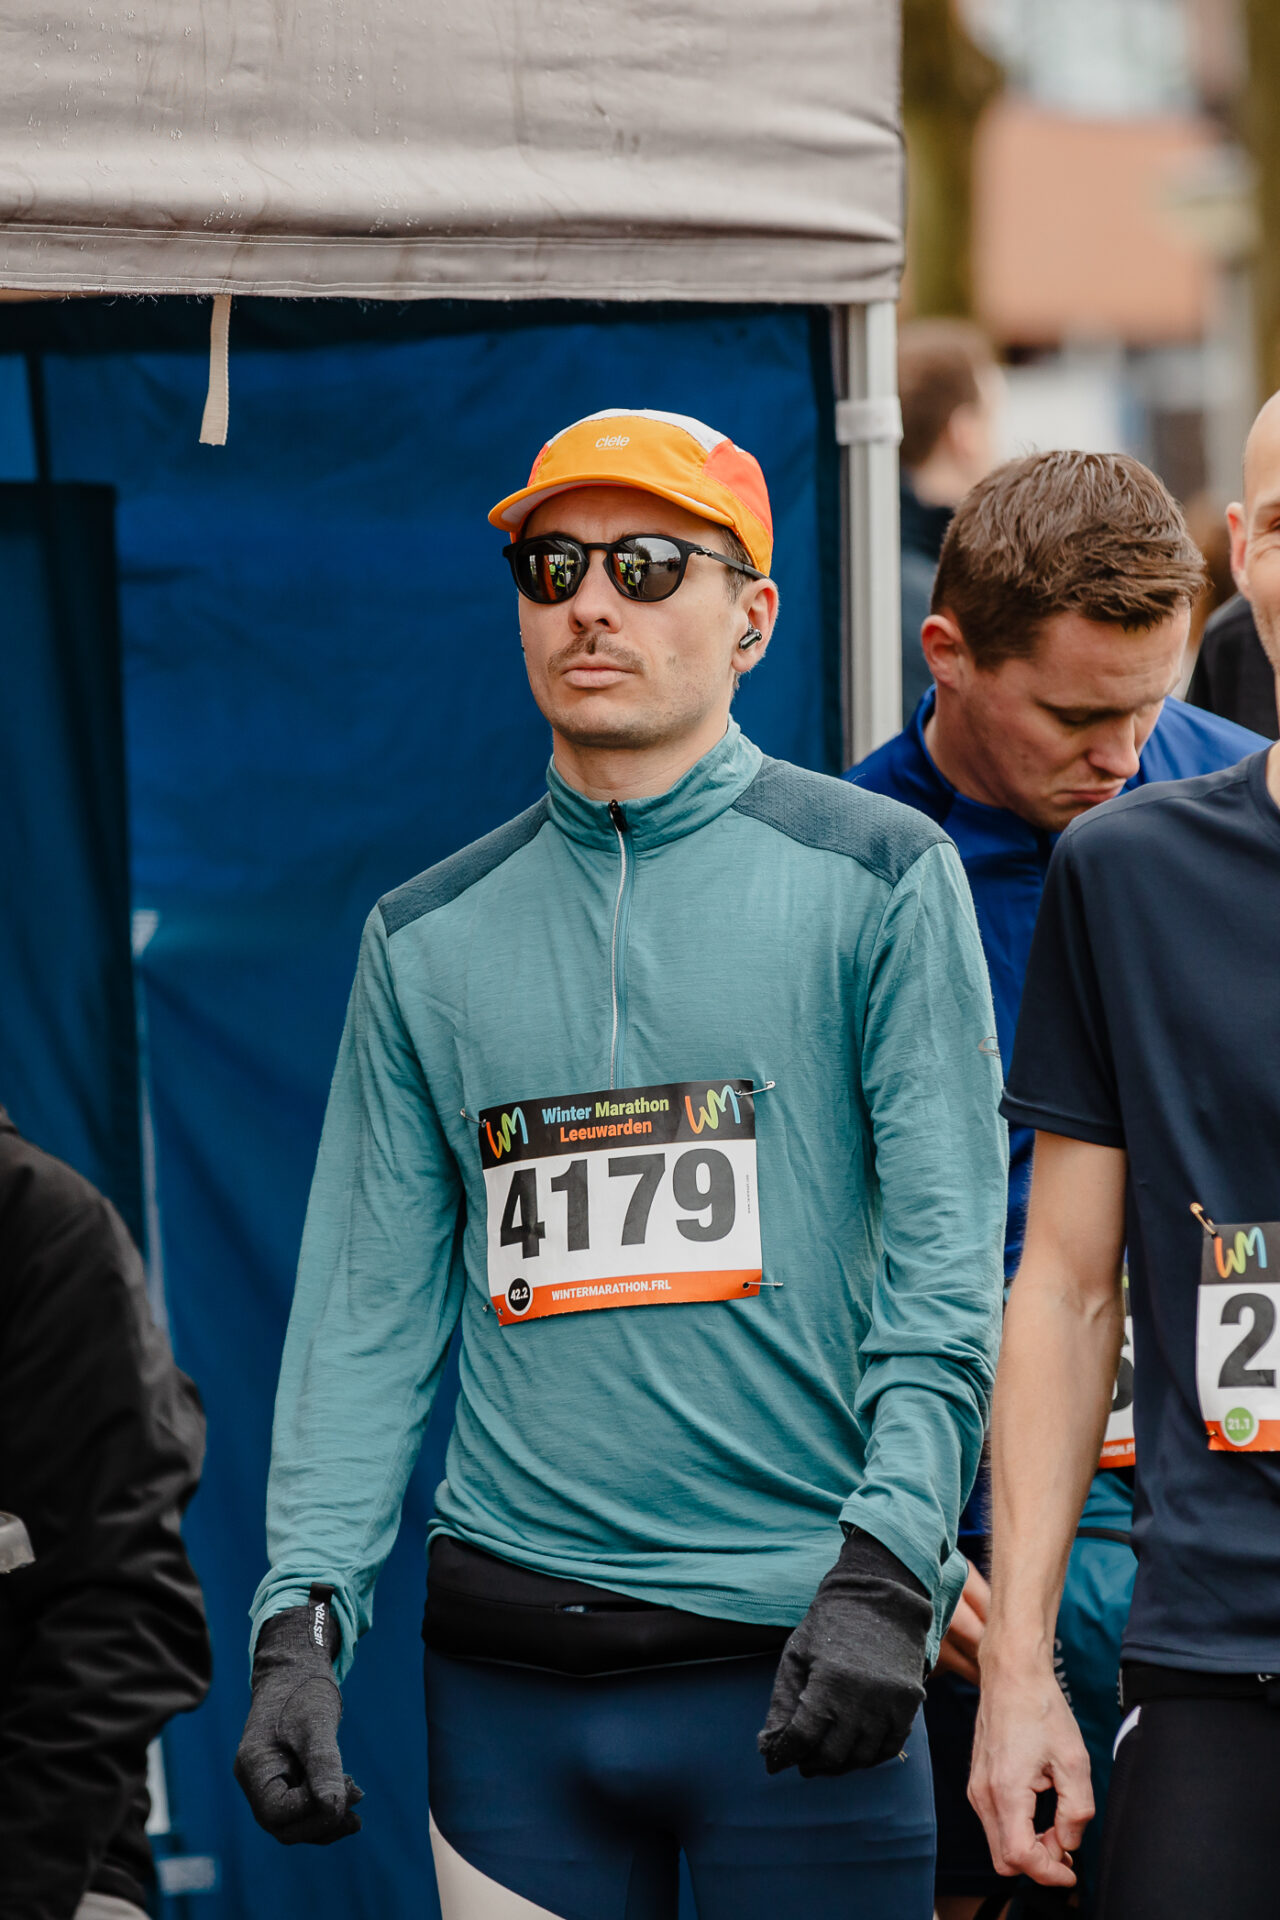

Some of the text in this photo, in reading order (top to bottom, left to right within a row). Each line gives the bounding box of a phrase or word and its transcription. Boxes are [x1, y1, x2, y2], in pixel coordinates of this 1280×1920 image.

[541, 1097, 670, 1125] Winter Marathon
[560, 1118, 653, 1143] Leeuwarden
[500, 1148, 736, 1260] 4179
[510, 1286, 529, 1301] 42.2
[551, 1279, 672, 1301] WINTERMARATHON.FRL
[1227, 1416, 1250, 1431] 21.1
[313, 1602, 325, 1647] HESTRA
